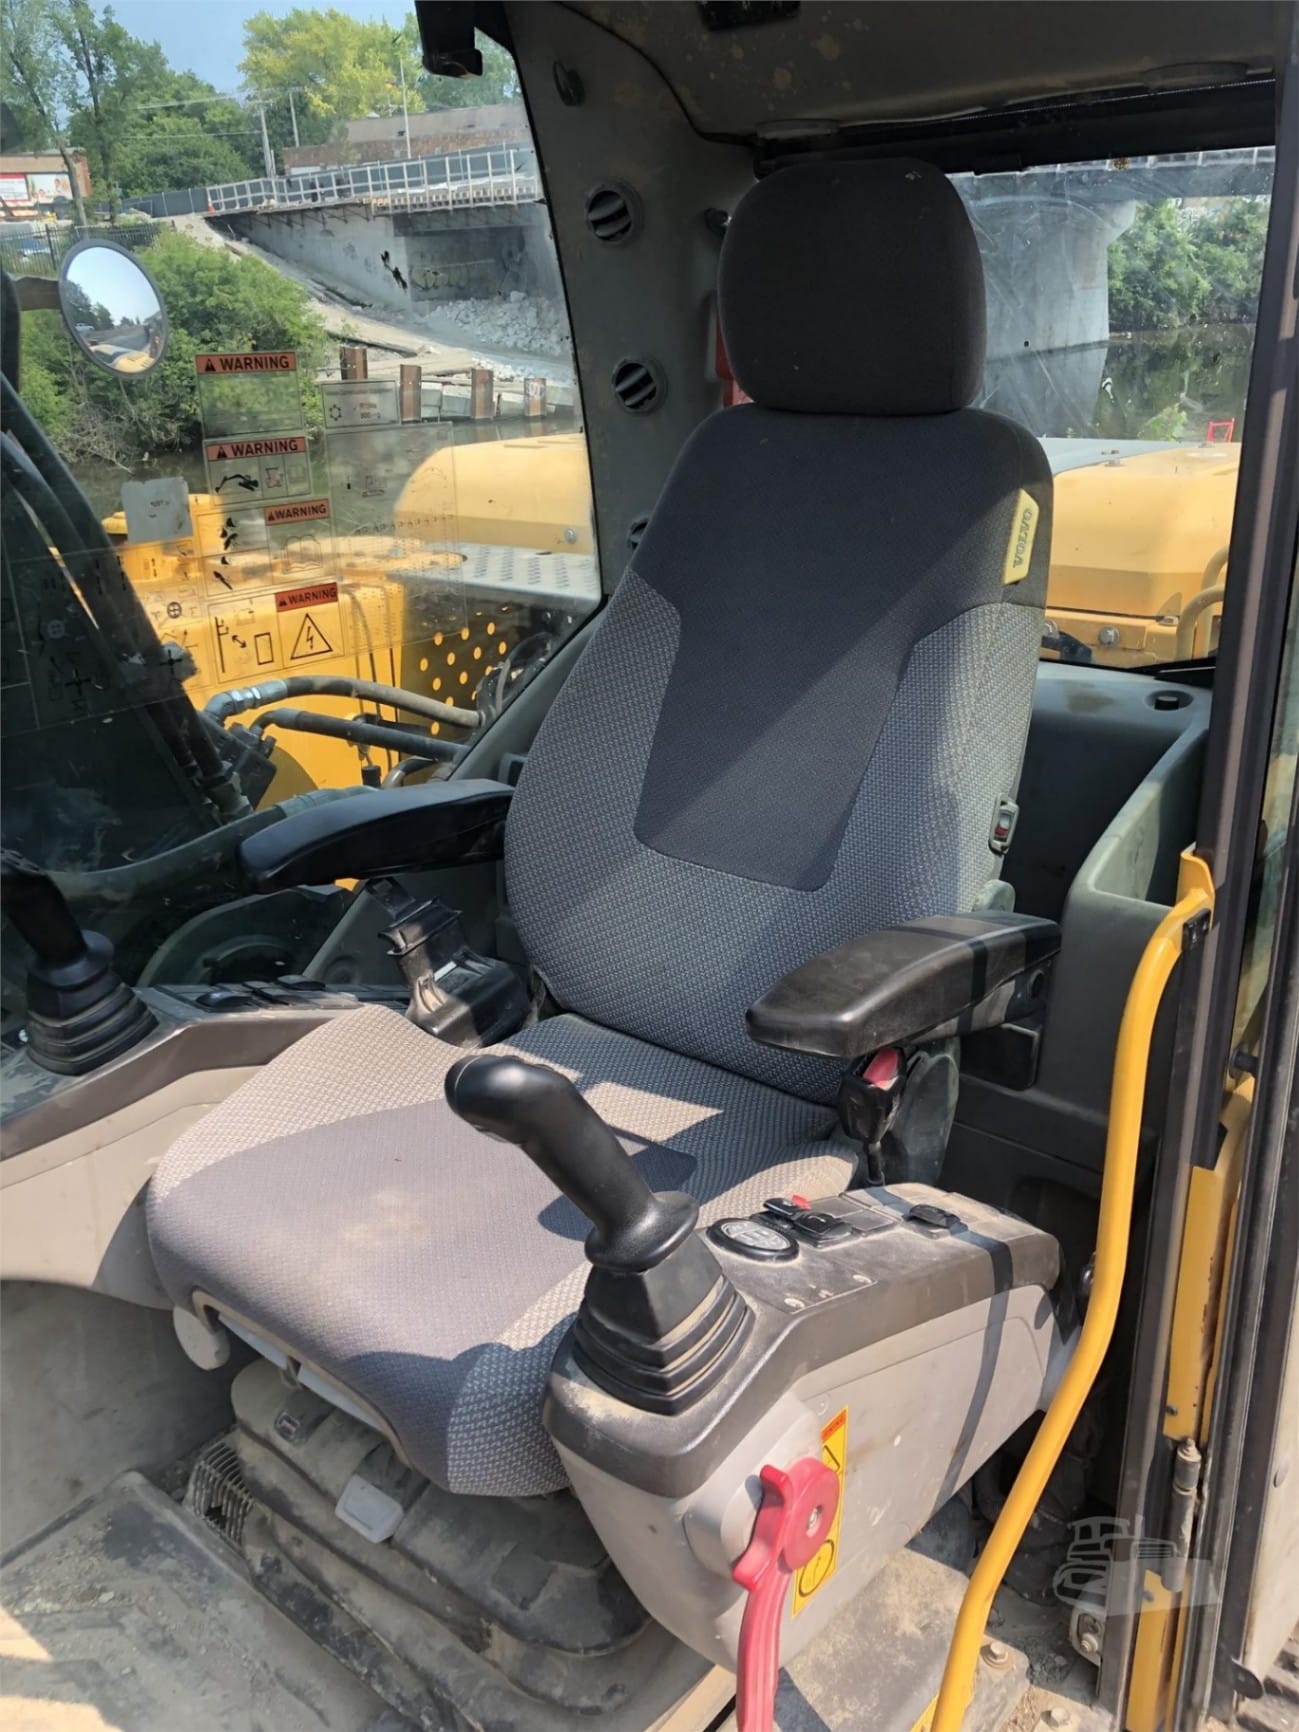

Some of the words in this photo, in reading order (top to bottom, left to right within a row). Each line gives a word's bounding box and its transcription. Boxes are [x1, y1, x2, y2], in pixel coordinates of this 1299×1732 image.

[220, 355, 289, 371] WARNING
[231, 439, 298, 457] WARNING
[275, 504, 327, 520] WARNING
[1012, 508, 1032, 568] VOLVO
[288, 587, 337, 604] WARNING
